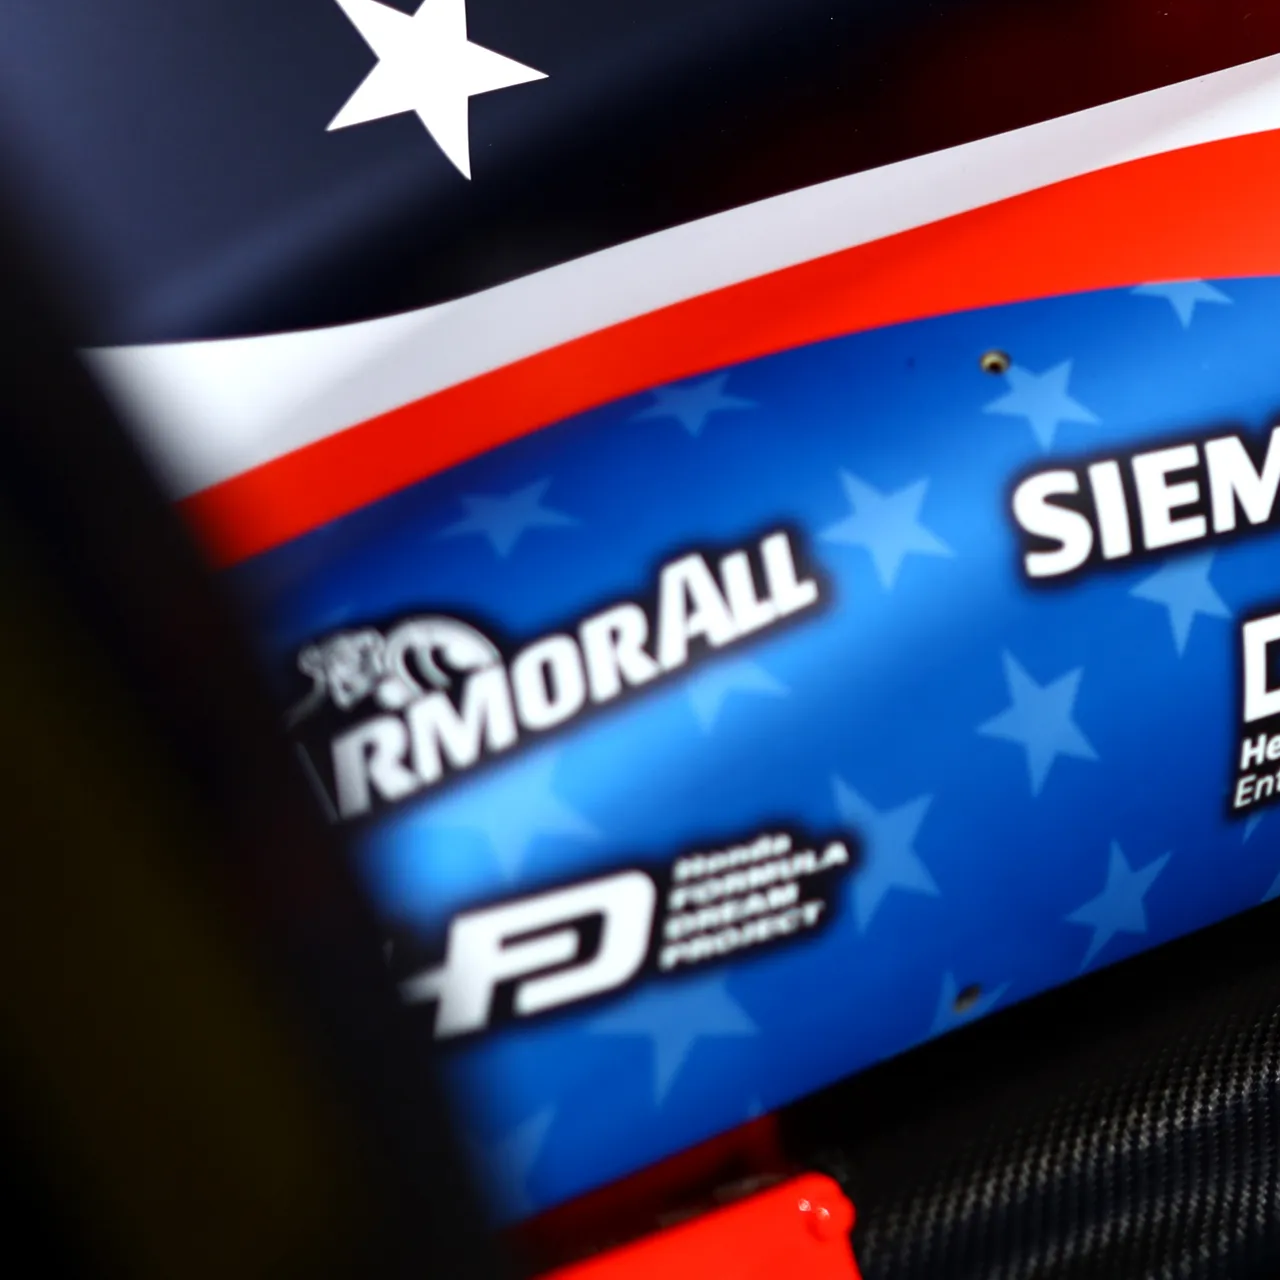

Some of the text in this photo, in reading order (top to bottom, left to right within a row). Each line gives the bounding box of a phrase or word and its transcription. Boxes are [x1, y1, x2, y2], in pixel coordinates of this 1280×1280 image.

[669, 840, 849, 912] FORMULA
[673, 833, 793, 884] Honda
[659, 898, 827, 973] PROJECT
